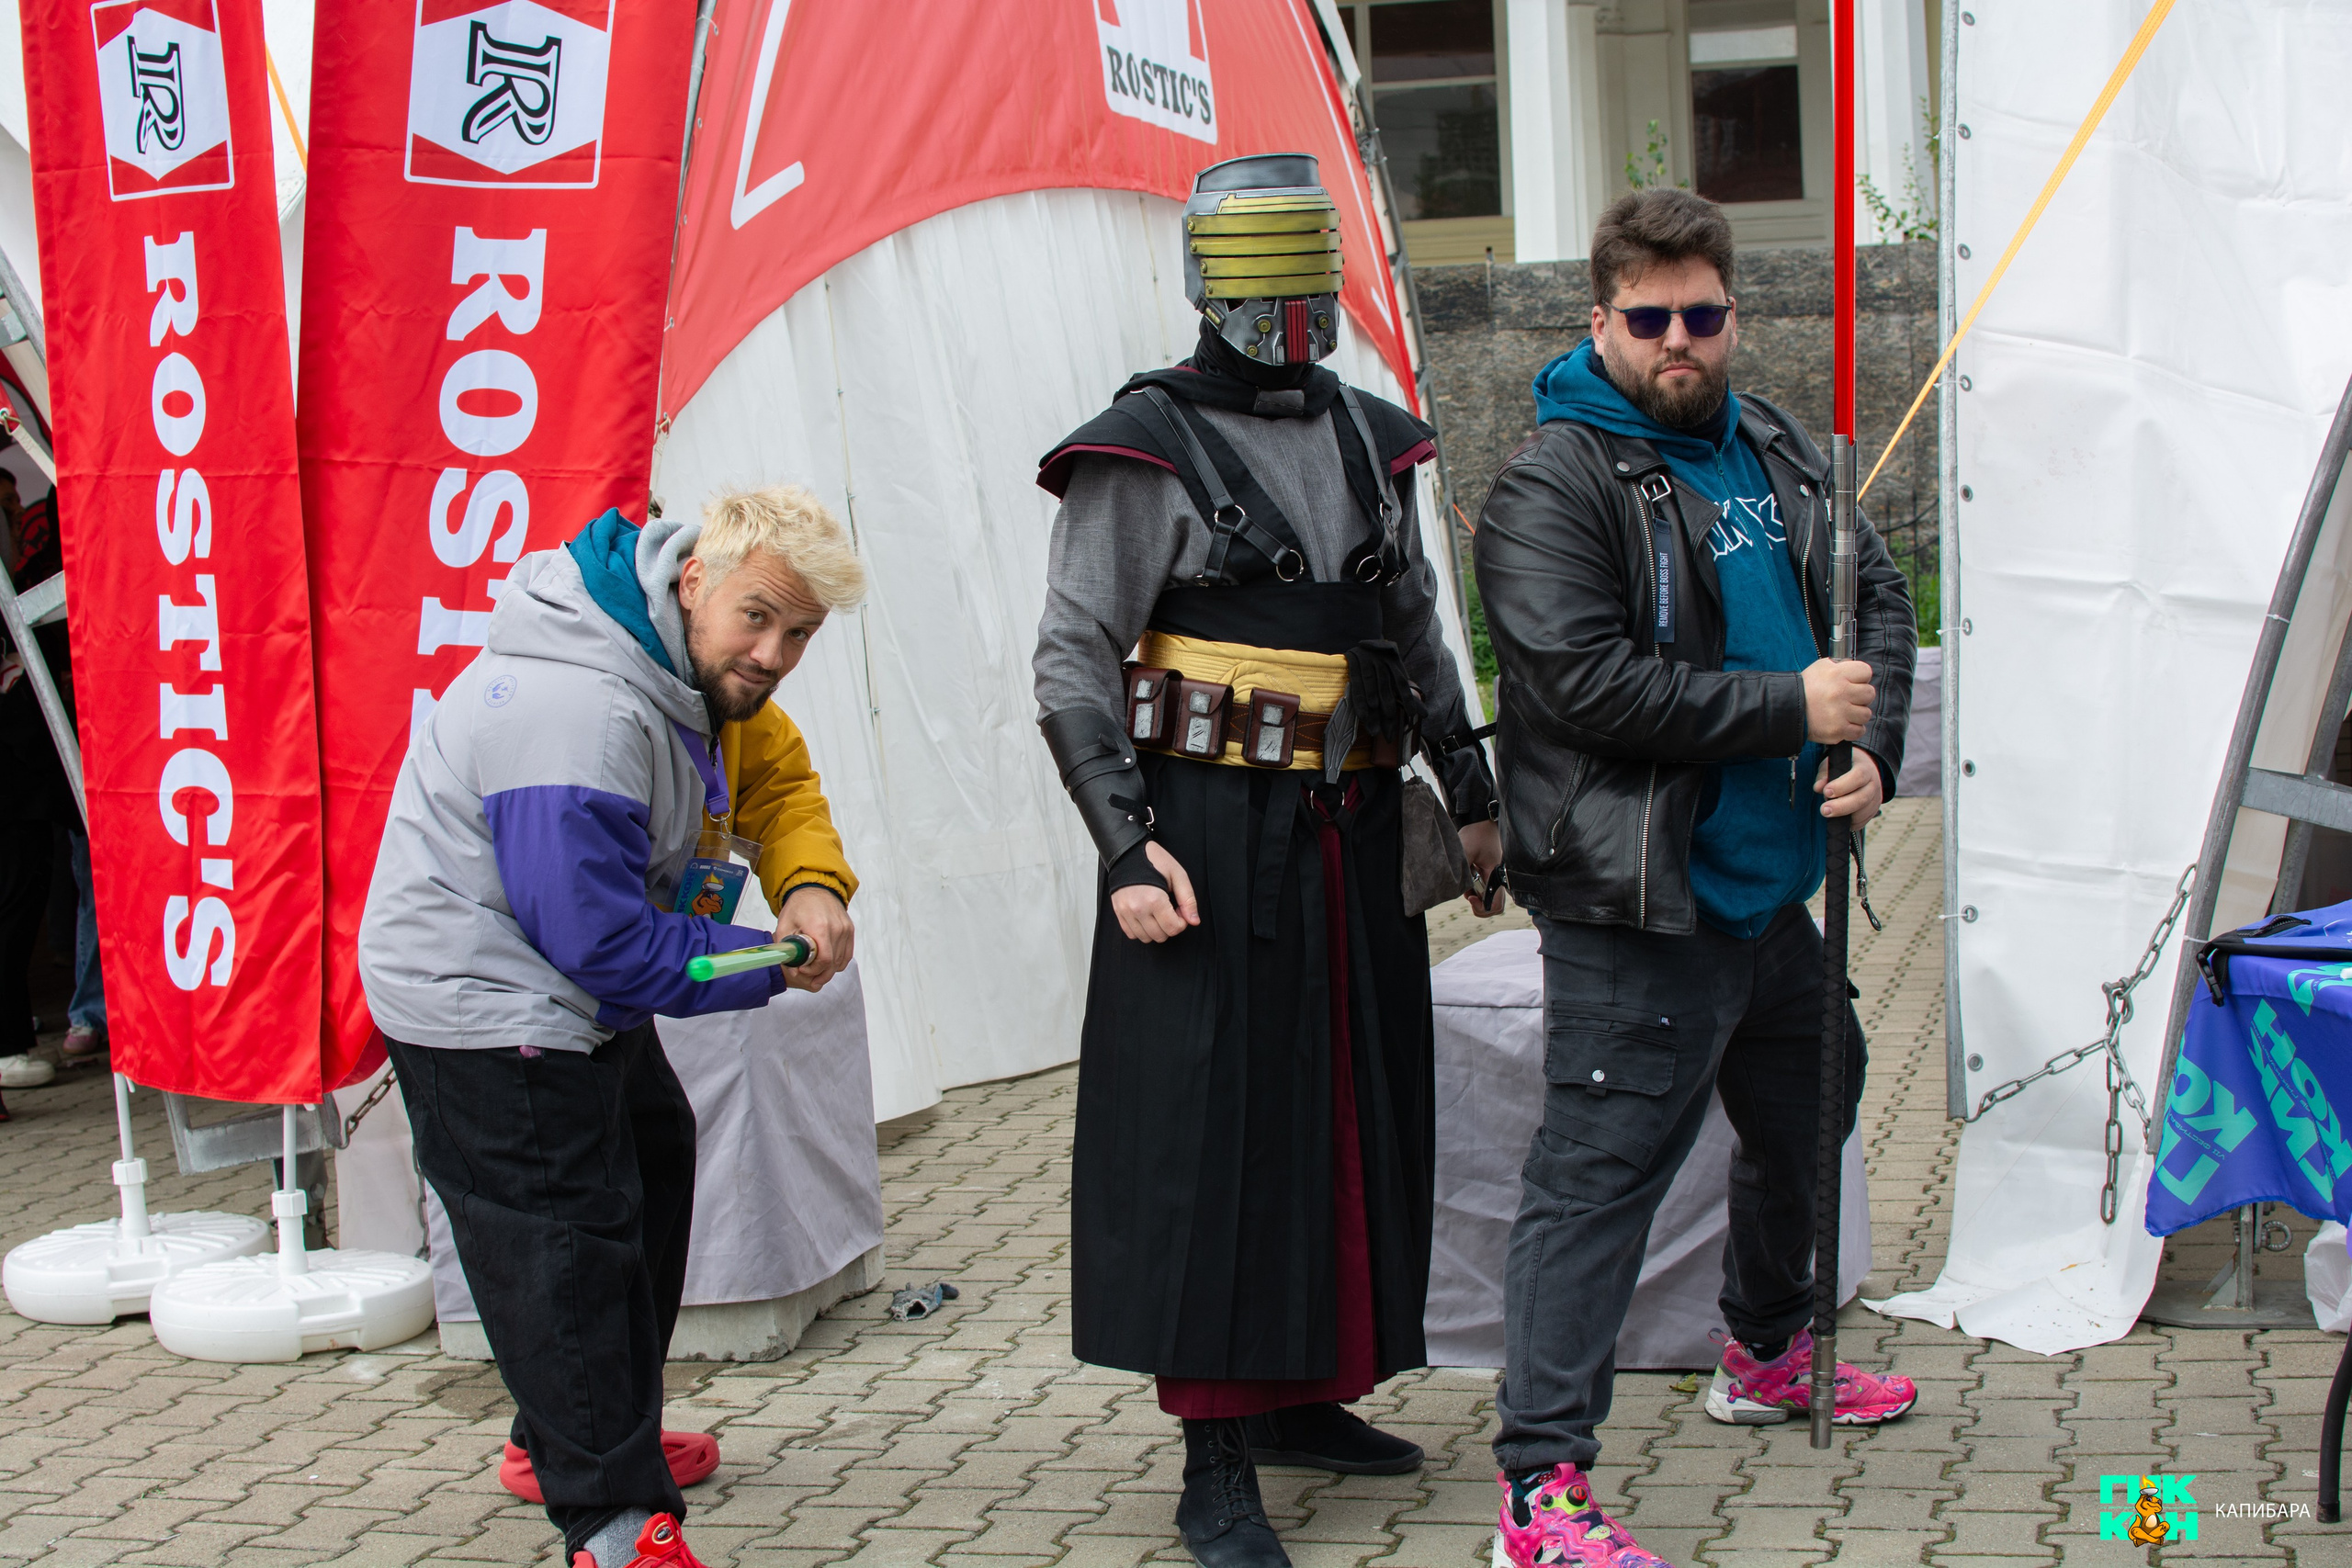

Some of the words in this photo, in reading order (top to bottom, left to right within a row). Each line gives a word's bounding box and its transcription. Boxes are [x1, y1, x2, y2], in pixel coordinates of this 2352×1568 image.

[1106, 45, 1211, 125] ROSTIC'S
[410, 226, 547, 740] ROST
[1659, 552, 1668, 568] FIGHT
[1659, 569, 1668, 583] BOSS
[1659, 583, 1668, 604] BEFORE
[144, 231, 235, 990] ROSTIC'S
[1658, 605, 1668, 627] REMOVE
